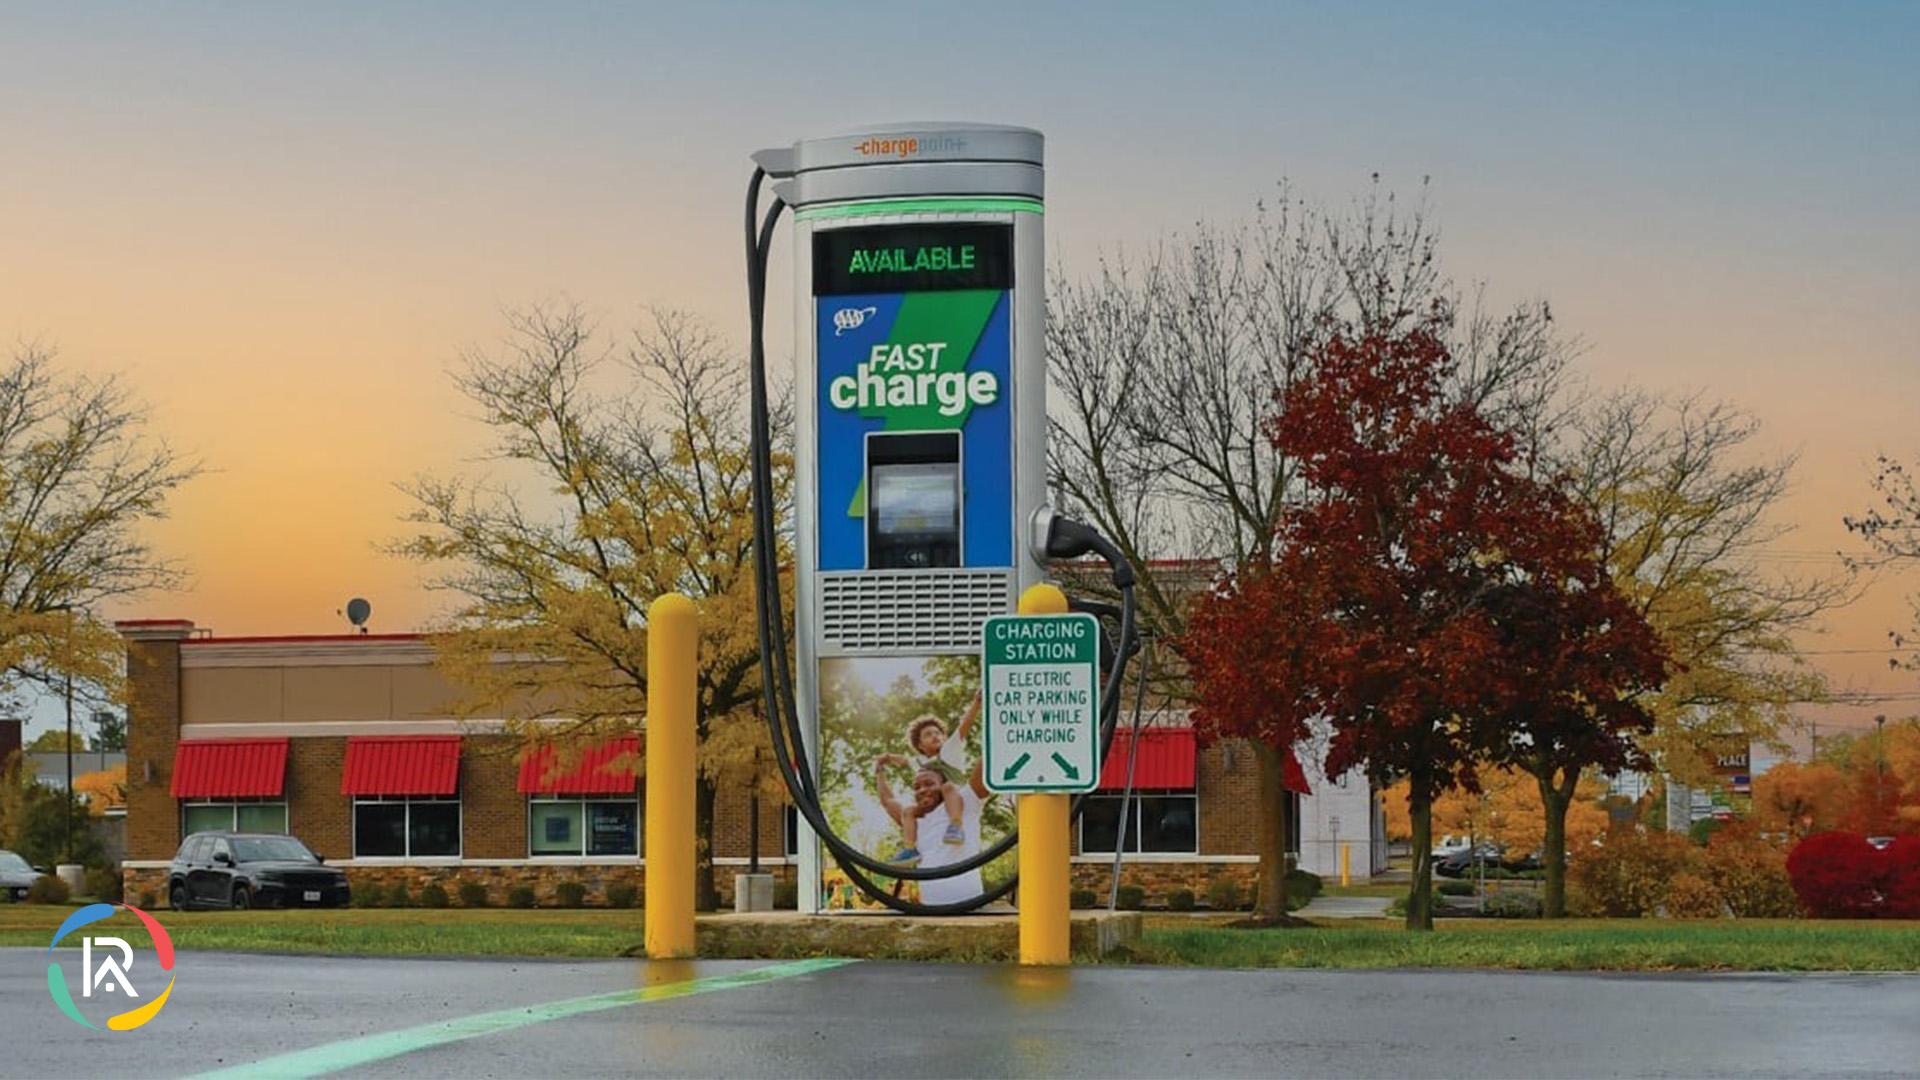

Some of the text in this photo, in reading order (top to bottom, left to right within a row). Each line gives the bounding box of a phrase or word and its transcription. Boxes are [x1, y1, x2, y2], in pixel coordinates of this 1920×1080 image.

[849, 245, 975, 274] AVAILABLE
[869, 343, 947, 372] FAST
[830, 363, 997, 416] charge
[995, 622, 1085, 640] CHARGING
[1005, 643, 1077, 660] STATION
[1008, 671, 1072, 687] ELECTRIC
[994, 690, 1088, 706] CAR PARKING
[999, 708, 1082, 726] ONLY WHILE
[1006, 728, 1077, 744] CHARGING
